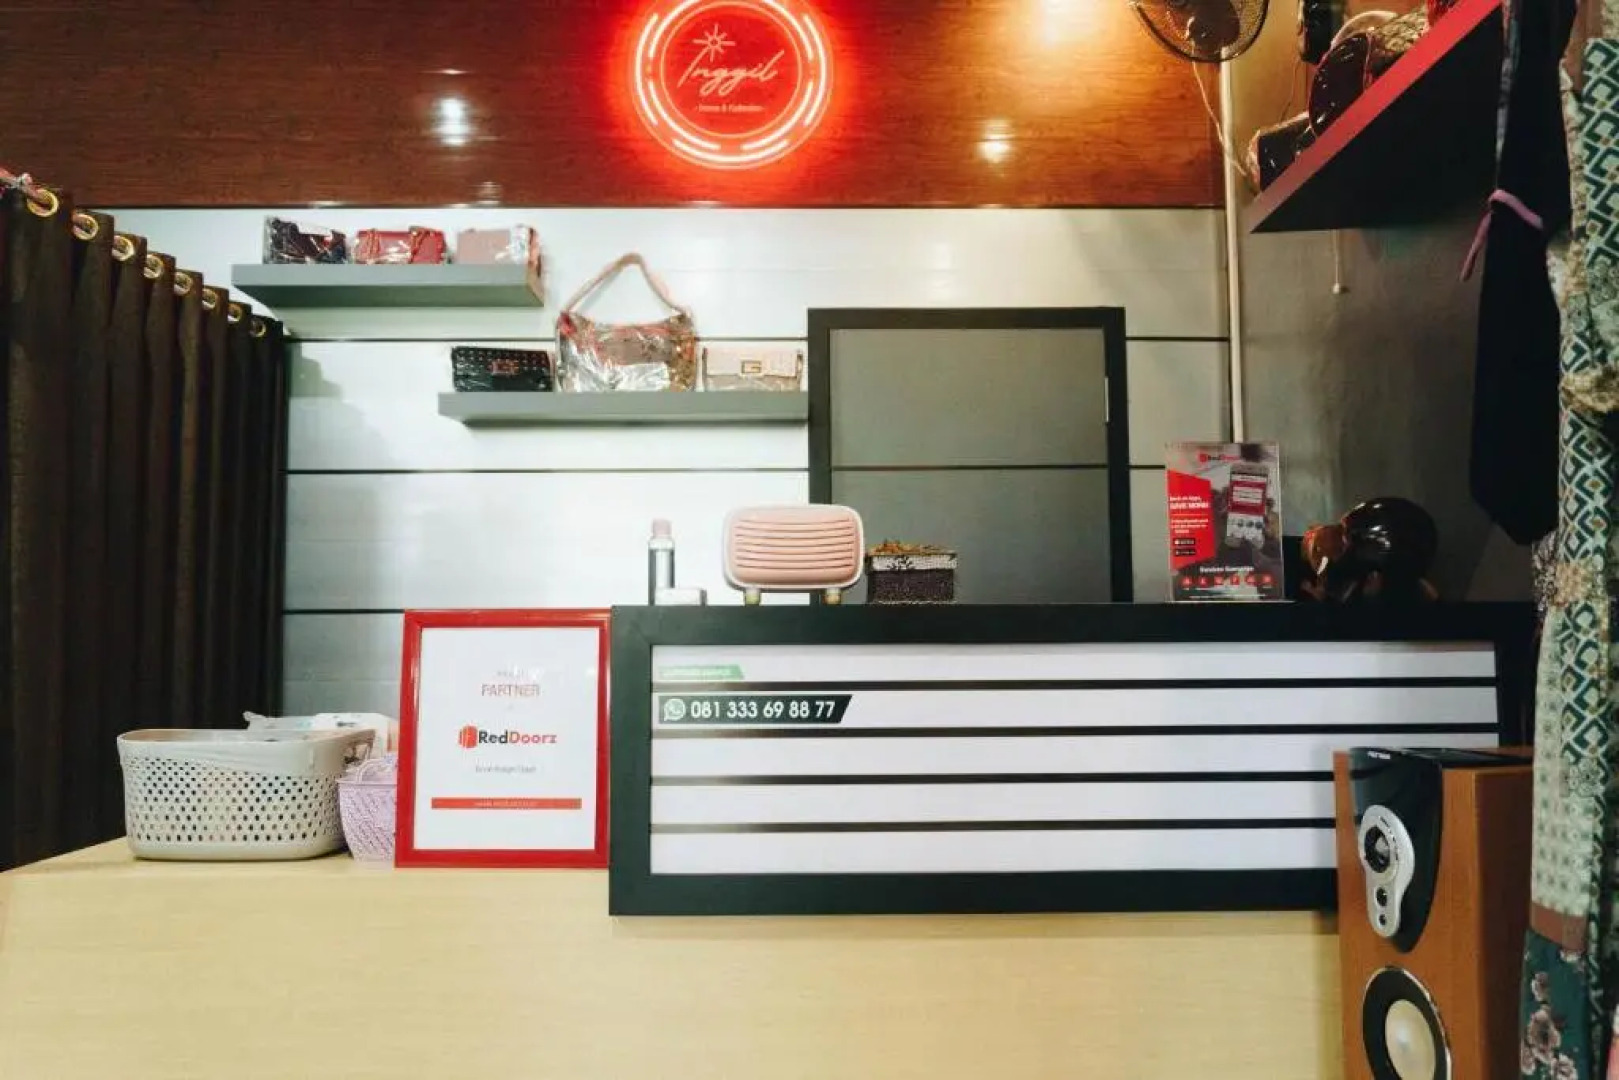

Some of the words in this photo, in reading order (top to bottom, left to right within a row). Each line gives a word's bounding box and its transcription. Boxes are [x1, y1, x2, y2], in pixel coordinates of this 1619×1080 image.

[481, 683, 541, 697] PARTNER
[690, 701, 722, 719] 081
[727, 701, 758, 719] 333
[763, 701, 785, 719] 69
[789, 701, 811, 719] 88
[815, 701, 836, 719] 77
[478, 729, 558, 744] RedDoorz
